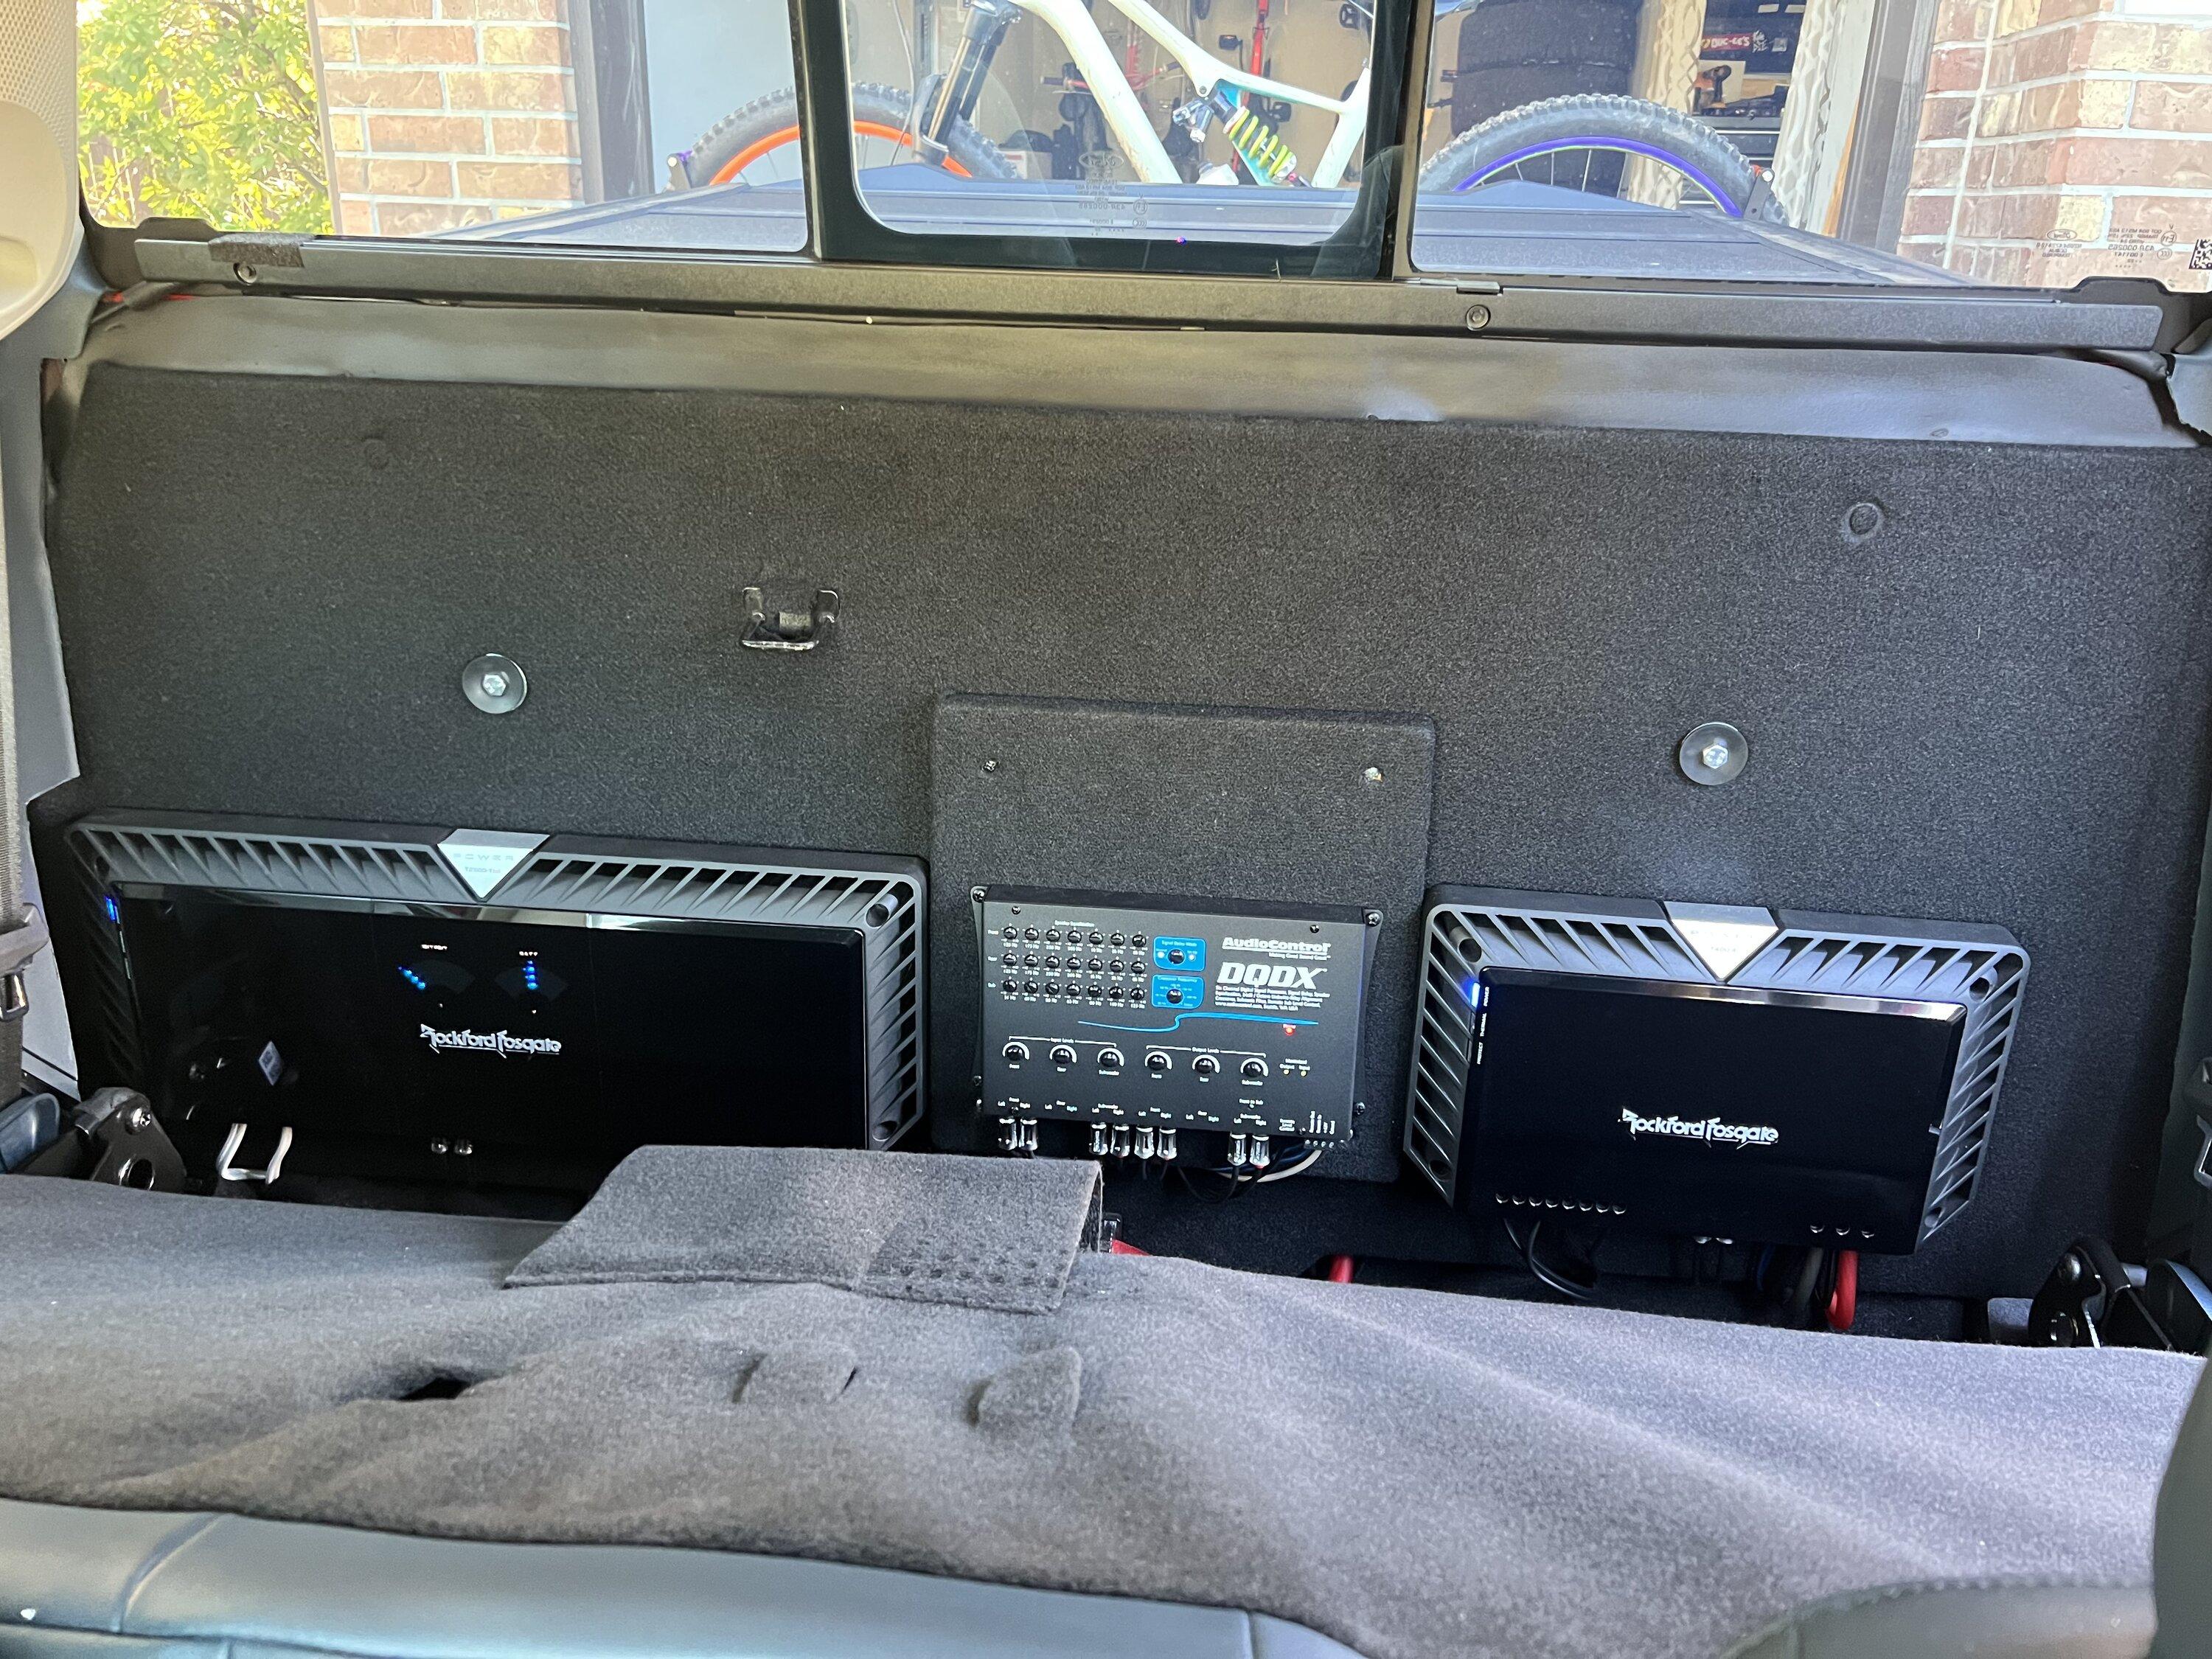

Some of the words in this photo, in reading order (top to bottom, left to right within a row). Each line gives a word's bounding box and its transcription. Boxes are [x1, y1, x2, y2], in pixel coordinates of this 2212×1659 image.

[1222, 936, 1330, 953] AudioControl
[1217, 961, 1323, 990] DQDX
[420, 1023, 497, 1050] Rockford
[496, 1029, 562, 1057] Fosgate
[1622, 1107, 1706, 1139] Rockford
[1706, 1117, 1779, 1145] Fosgate
